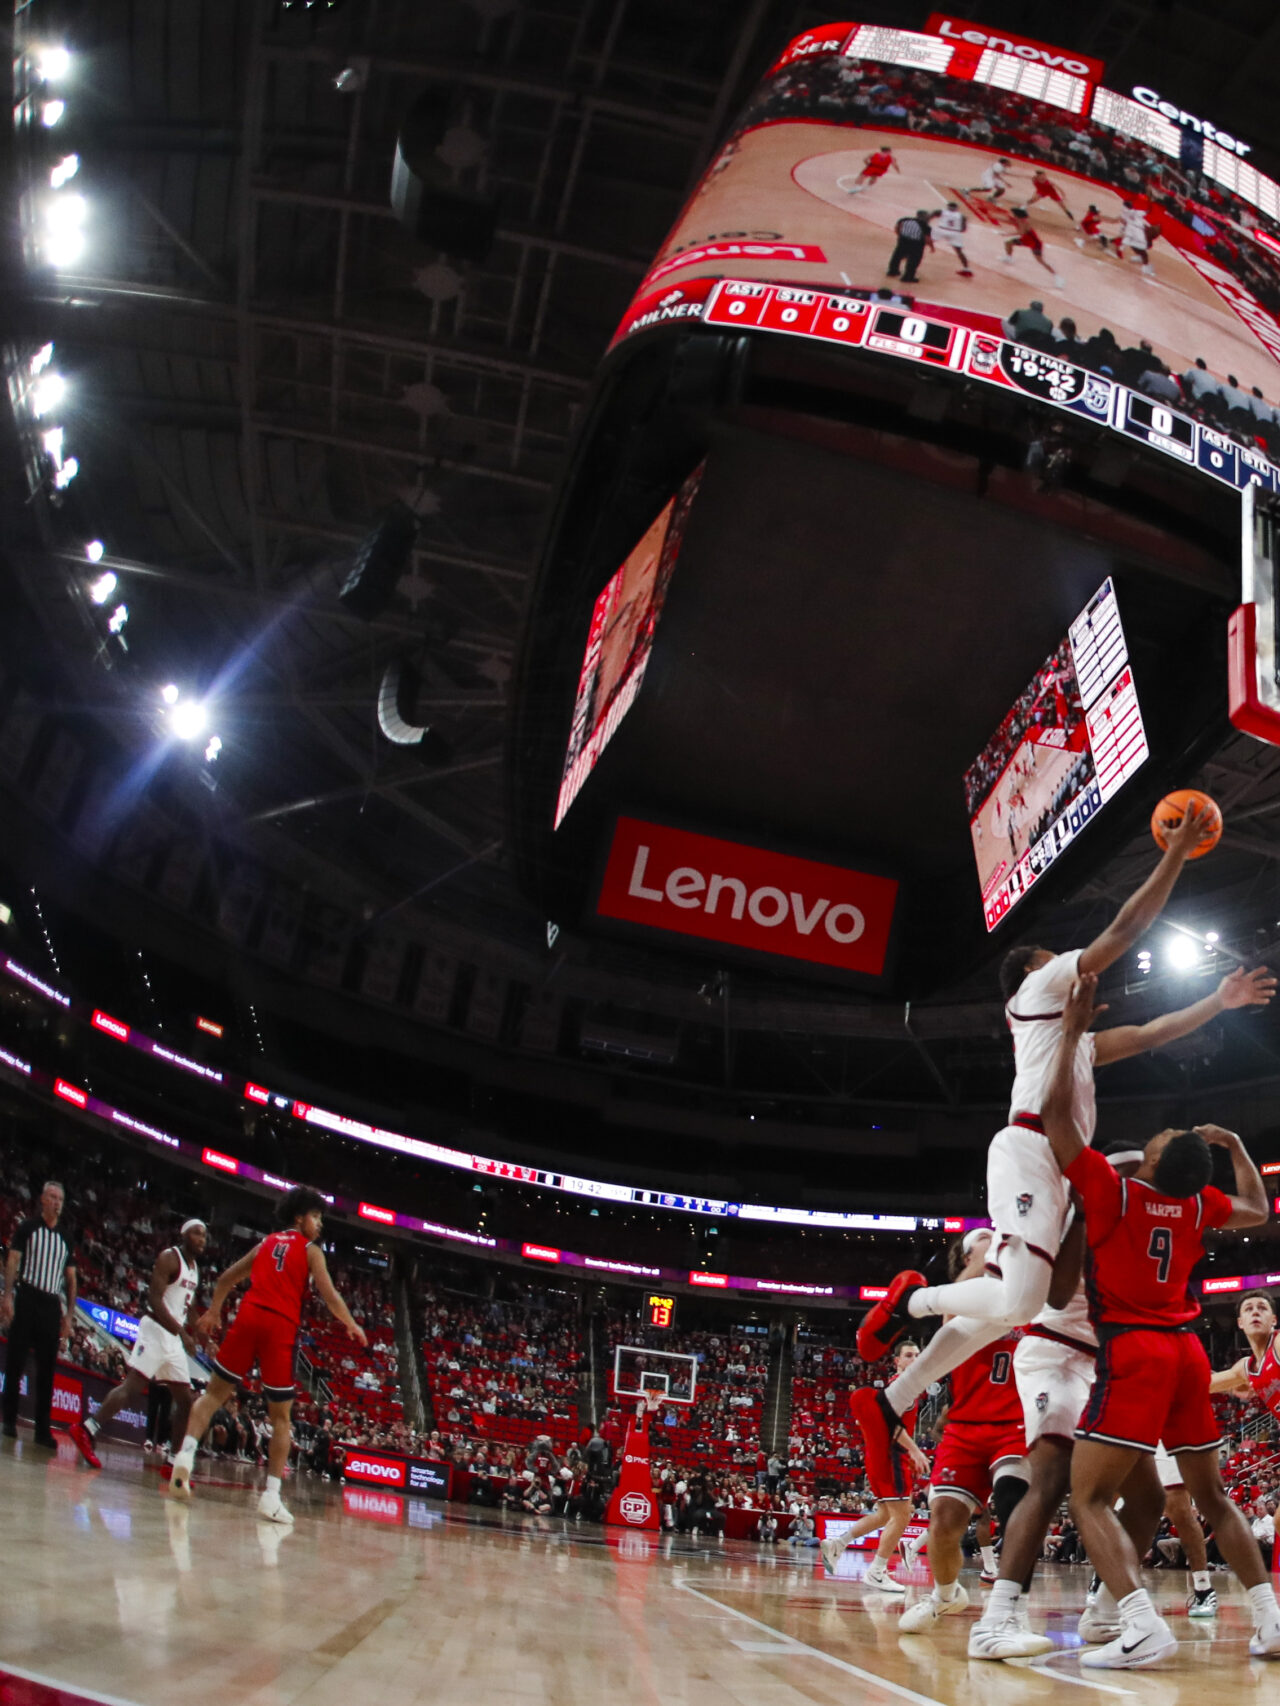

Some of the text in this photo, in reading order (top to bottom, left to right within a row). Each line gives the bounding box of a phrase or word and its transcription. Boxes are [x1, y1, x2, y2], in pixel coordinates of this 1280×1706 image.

[939, 20, 1089, 75] Lenovo
[1132, 86, 1252, 156] Center
[728, 282, 862, 313] AST STL TO
[629, 303, 702, 333] MILNER
[728, 301, 849, 331] 0 0 0
[900, 317, 927, 344] 0
[1013, 347, 1075, 375] 1ST HALF
[1010, 357, 1076, 393] 19:42
[1151, 407, 1174, 435] 0
[1204, 429, 1230, 451] AST
[1210, 451, 1224, 468] 0
[627, 845, 866, 943] Lenovo
[96, 1015, 126, 1036] Lenovo
[58, 1083, 85, 1103] Lenovo
[206, 1152, 236, 1169] Lenovo
[363, 1206, 393, 1221] Lenovo
[1146, 1202, 1182, 1218] HARPER
[271, 1243, 290, 1272] 4
[526, 1246, 557, 1259] Lenovo
[1147, 1226, 1172, 1283] 9
[693, 1274, 725, 1285] Lenovo
[1206, 1281, 1239, 1290] Lenovo
[652, 1307, 670, 1327] 13
[989, 1351, 1012, 1384] 0
[410, 1466, 436, 1476] Smarter
[633, 1456, 649, 1465] PNC
[410, 1473, 445, 1486] technology
[624, 1502, 648, 1513] CPI
